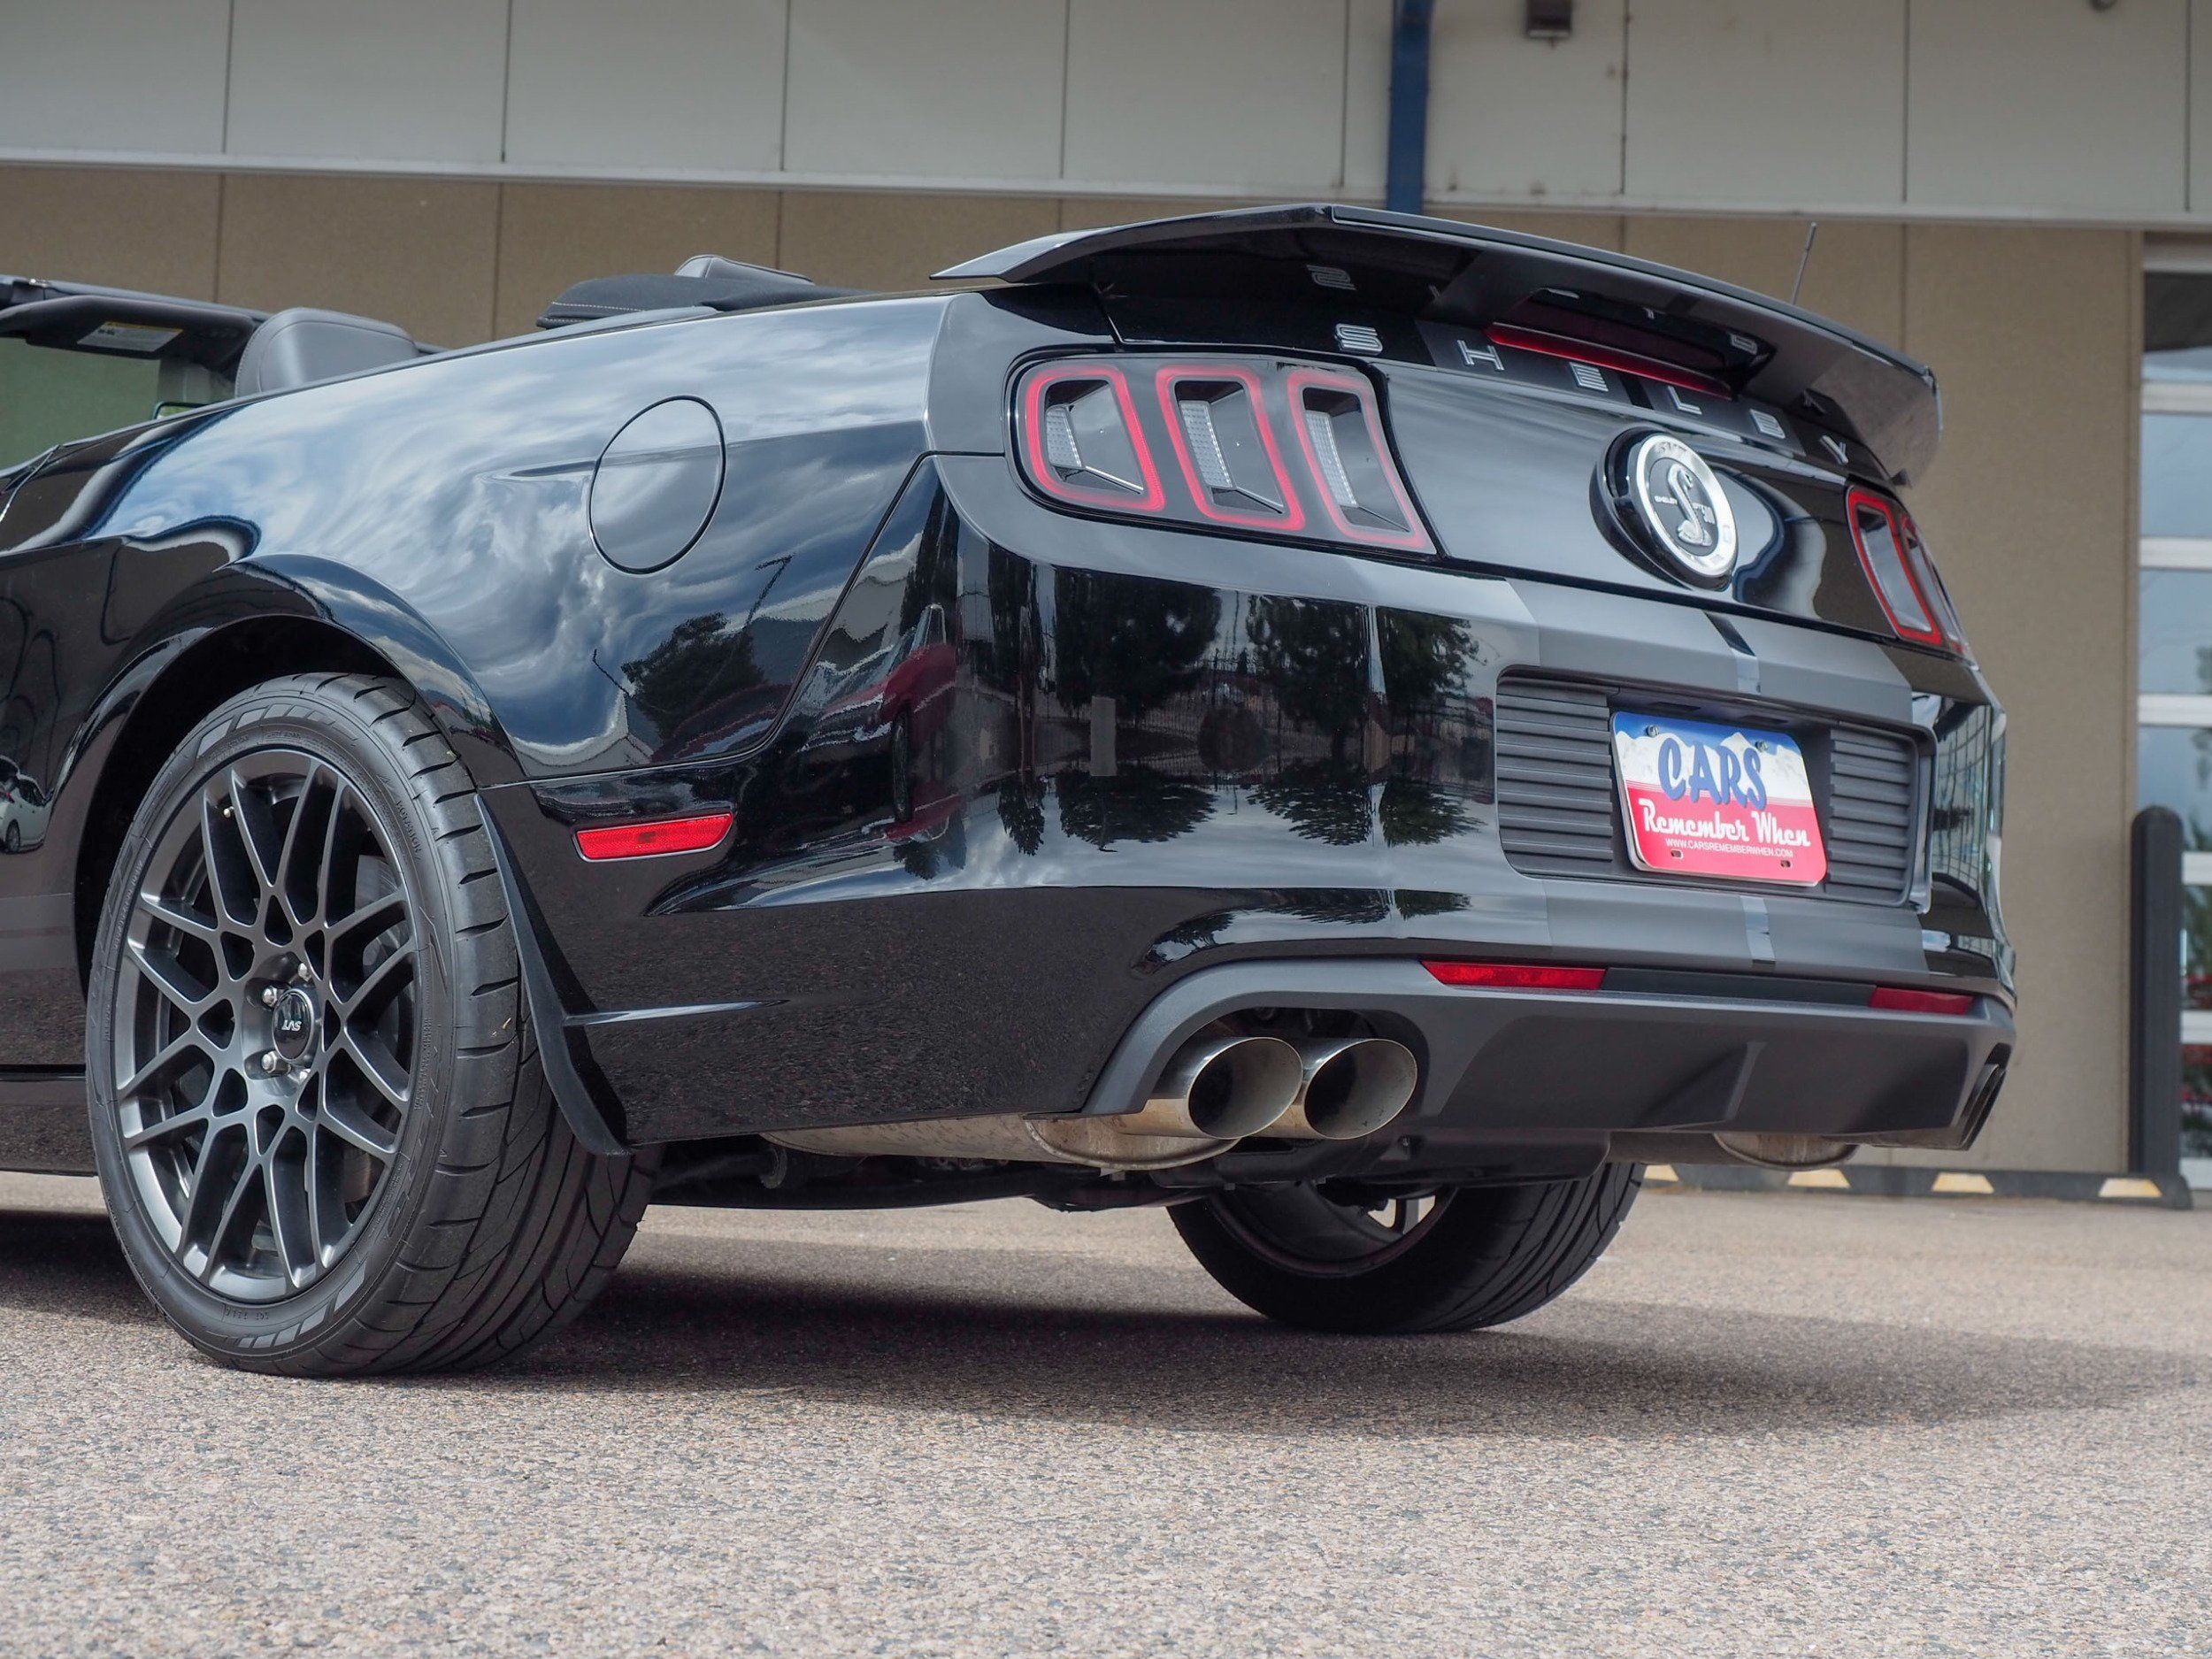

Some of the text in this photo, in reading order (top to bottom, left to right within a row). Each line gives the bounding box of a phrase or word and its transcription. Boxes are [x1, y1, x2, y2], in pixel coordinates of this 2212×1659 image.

[1335, 323, 1848, 465] SHELBY
[1657, 737, 1768, 810] CARS
[1640, 798, 1811, 847] Remember When
[1665, 837, 1793, 858] WWW.CARSREMEMBERWHEN.COM
